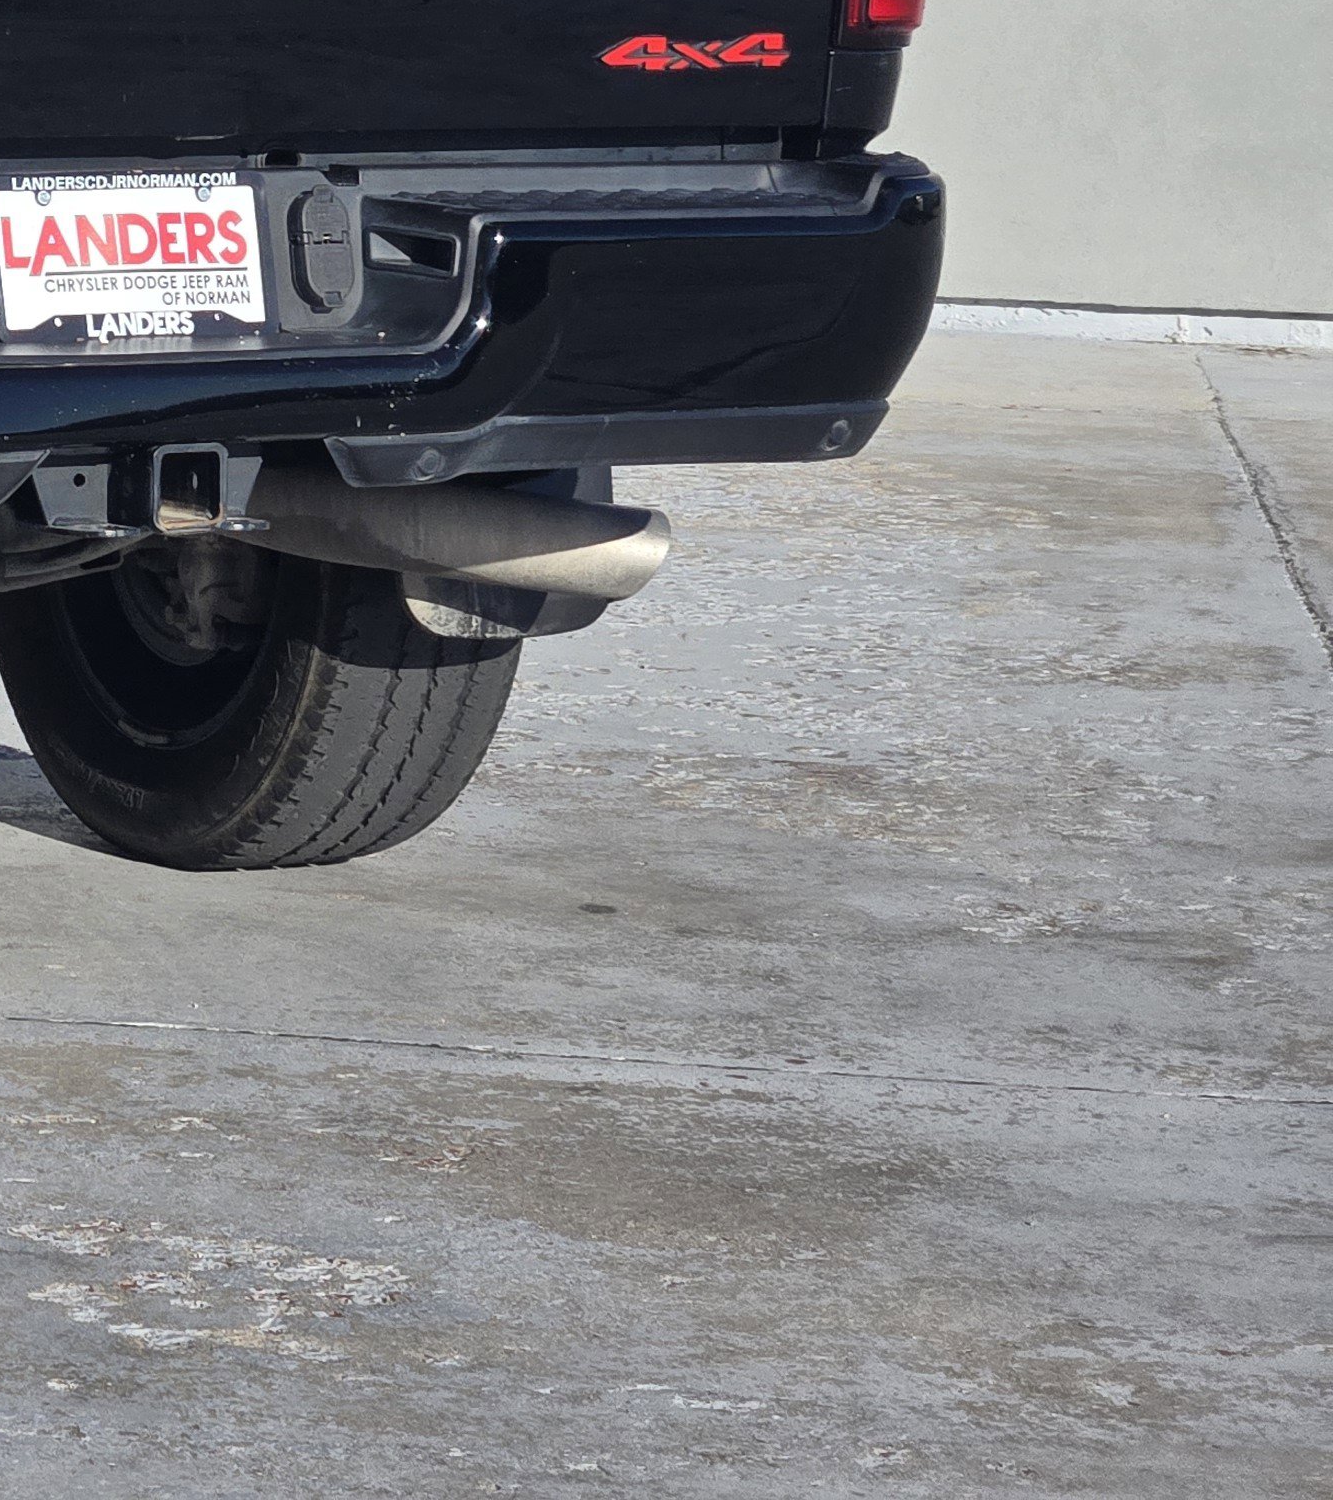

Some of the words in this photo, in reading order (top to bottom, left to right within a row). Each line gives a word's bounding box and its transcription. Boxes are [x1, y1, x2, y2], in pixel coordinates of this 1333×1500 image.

[11, 172, 236, 191] LANDERSCDJRNORMAN.COM
[0, 210, 248, 276] LANDERS
[44, 278, 119, 293] CHRYSLER
[123, 275, 178, 290] DODGE
[182, 276, 210, 289] JEEP
[216, 274, 249, 288] RAM
[162, 292, 182, 306] OF
[185, 290, 251, 305] NORMAN
[85, 311, 195, 344] LANDERS
